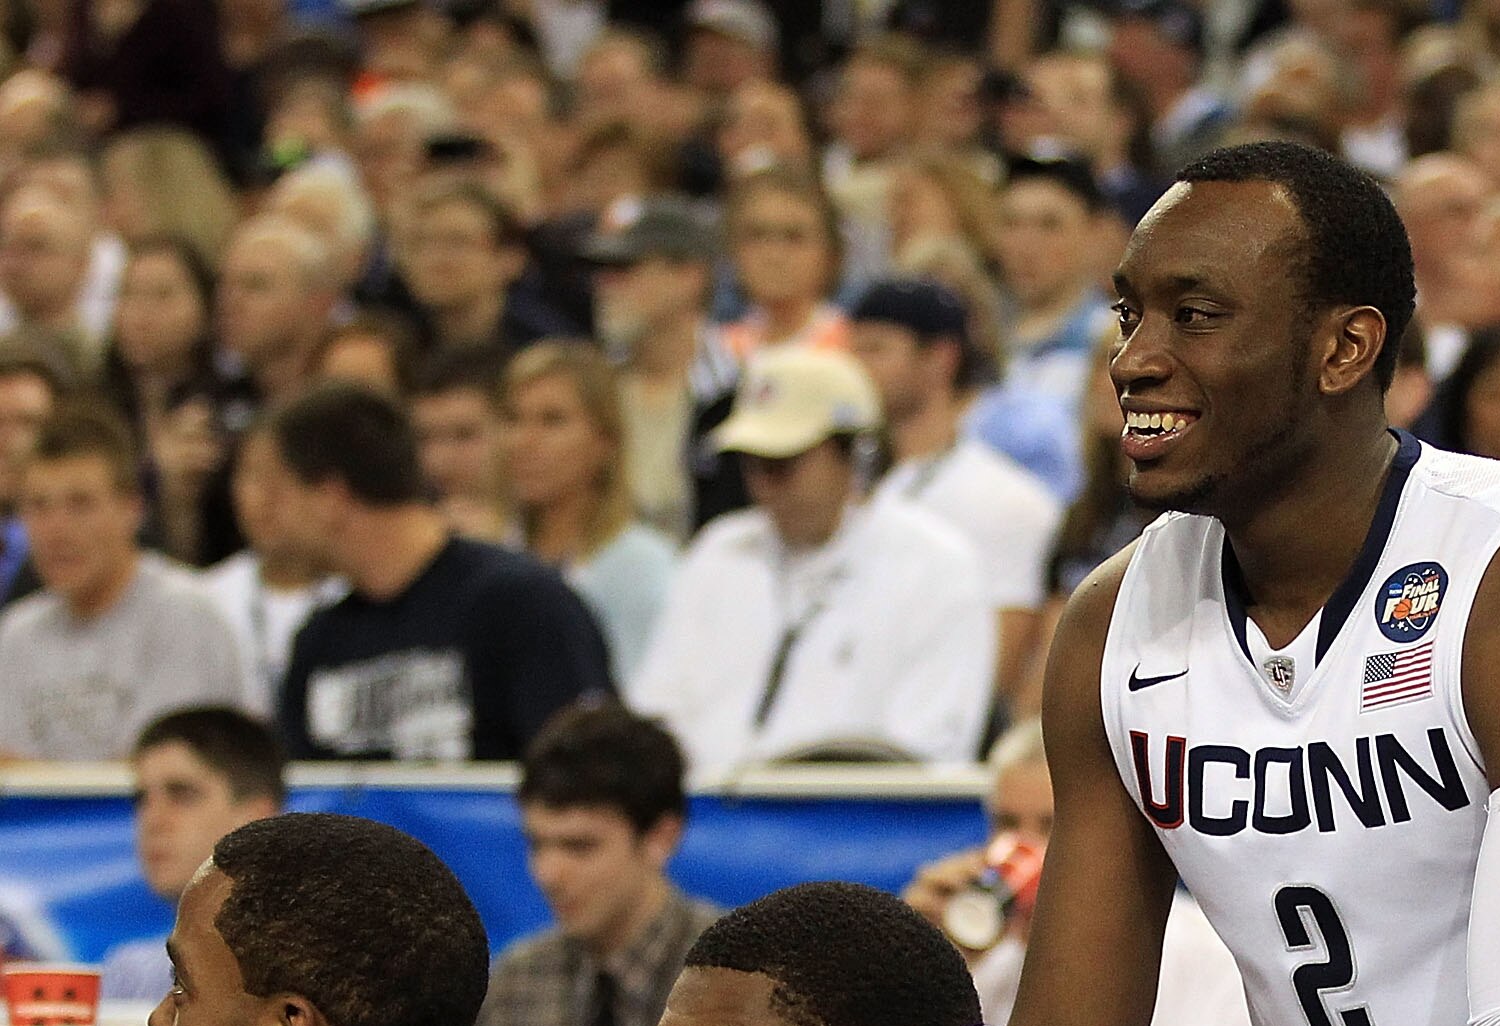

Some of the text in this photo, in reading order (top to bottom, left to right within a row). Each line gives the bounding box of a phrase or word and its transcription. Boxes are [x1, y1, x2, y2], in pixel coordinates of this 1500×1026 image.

[1402, 579, 1440, 599] FINAL
[1382, 592, 1439, 623] FOUR
[1130, 728, 1471, 836] UCONN
